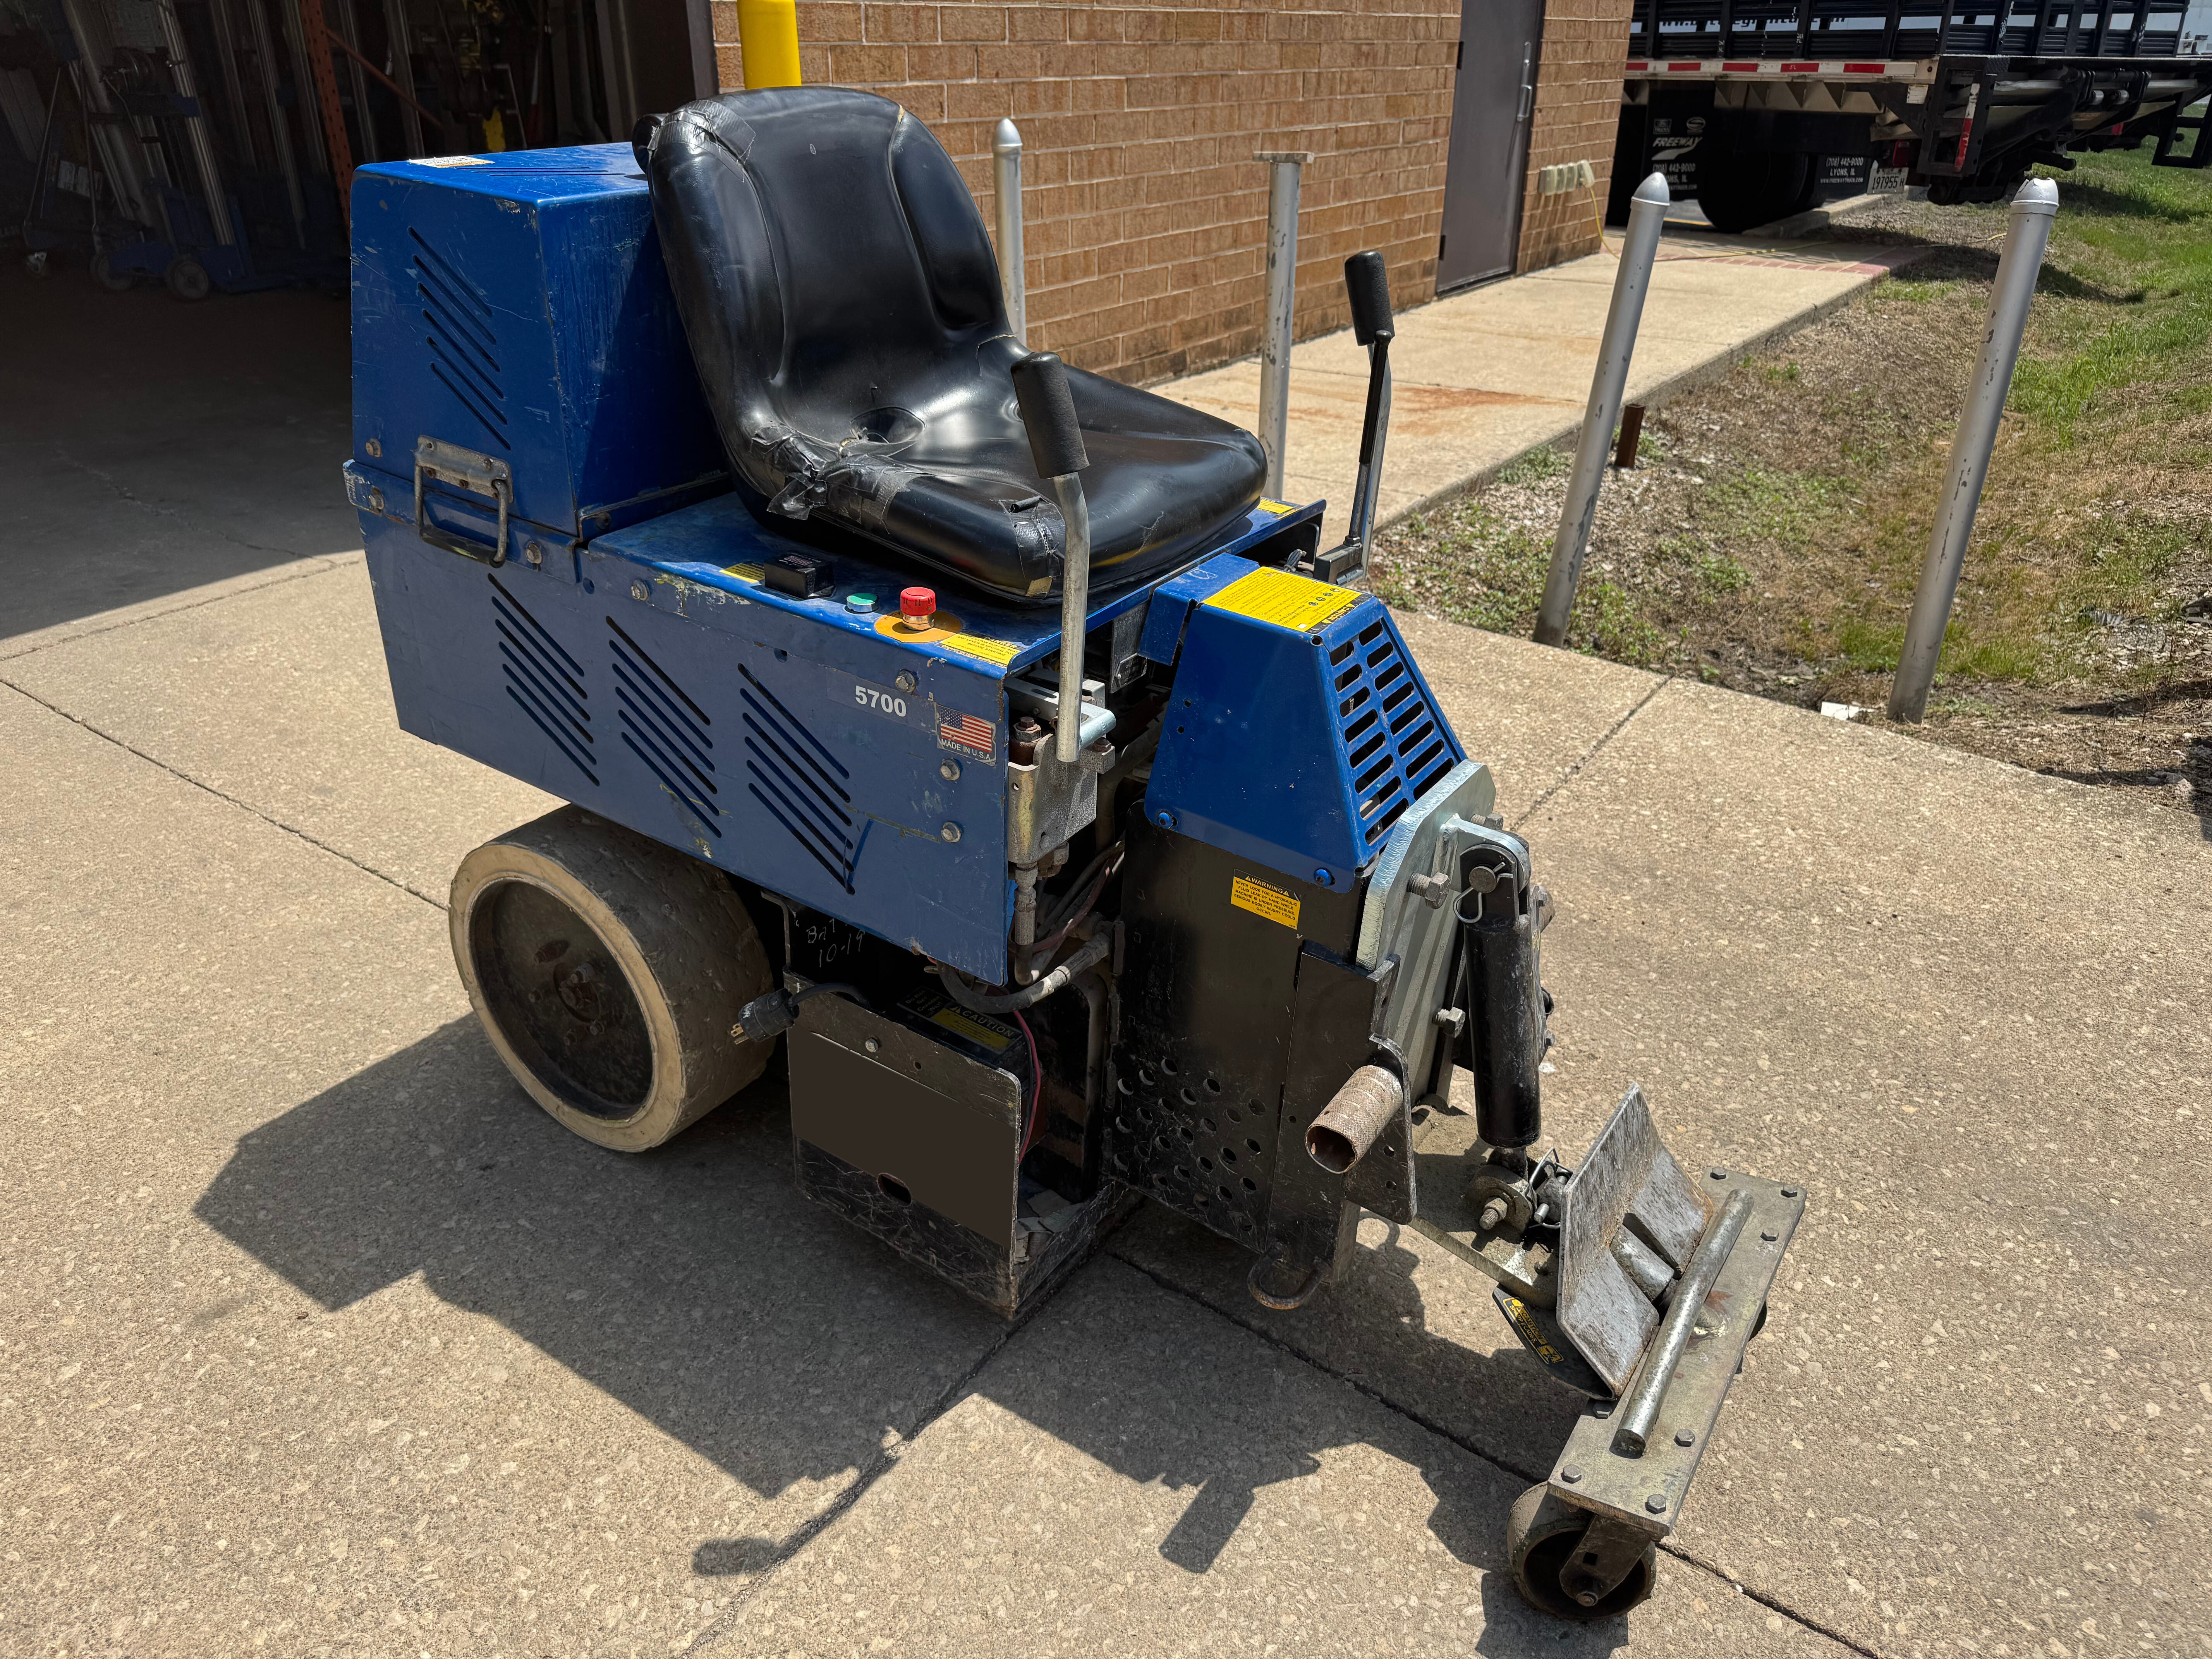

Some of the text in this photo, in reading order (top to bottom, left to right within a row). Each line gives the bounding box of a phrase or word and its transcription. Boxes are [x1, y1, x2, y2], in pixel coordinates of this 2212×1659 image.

[1653, 137, 1703, 147] FREEWAY
[1669, 163, 1696, 172] 442-9000
[1826, 157, 1863, 167] (708) 442-9000
[1830, 168, 1855, 177] LYONS, IL
[1872, 176, 1905, 190] 197955 H
[1328, 607, 1349, 620] CAUTION
[984, 637, 1017, 648] DANGER
[855, 685, 907, 717] 5700
[941, 738, 991, 761] MADE IN U.S.A
[1252, 878, 1283, 894] WARNING
[1234, 893, 1295, 921] SERIOUS BODILY INJURY COULD
[1235, 889, 1253, 898] MACHINE
[1259, 898, 1272, 907] UNDER
[1273, 904, 1295, 915] PRESSURE.
[1275, 895, 1298, 907] HYDRAULIC
[1281, 902, 1293, 910] WHILE
[1256, 907, 1271, 915] OCCUR.
[819, 930, 865, 968] 10-19
[963, 1010, 1015, 1037] CAUTION
[1510, 1305, 1537, 1343] SHARP BLADES
